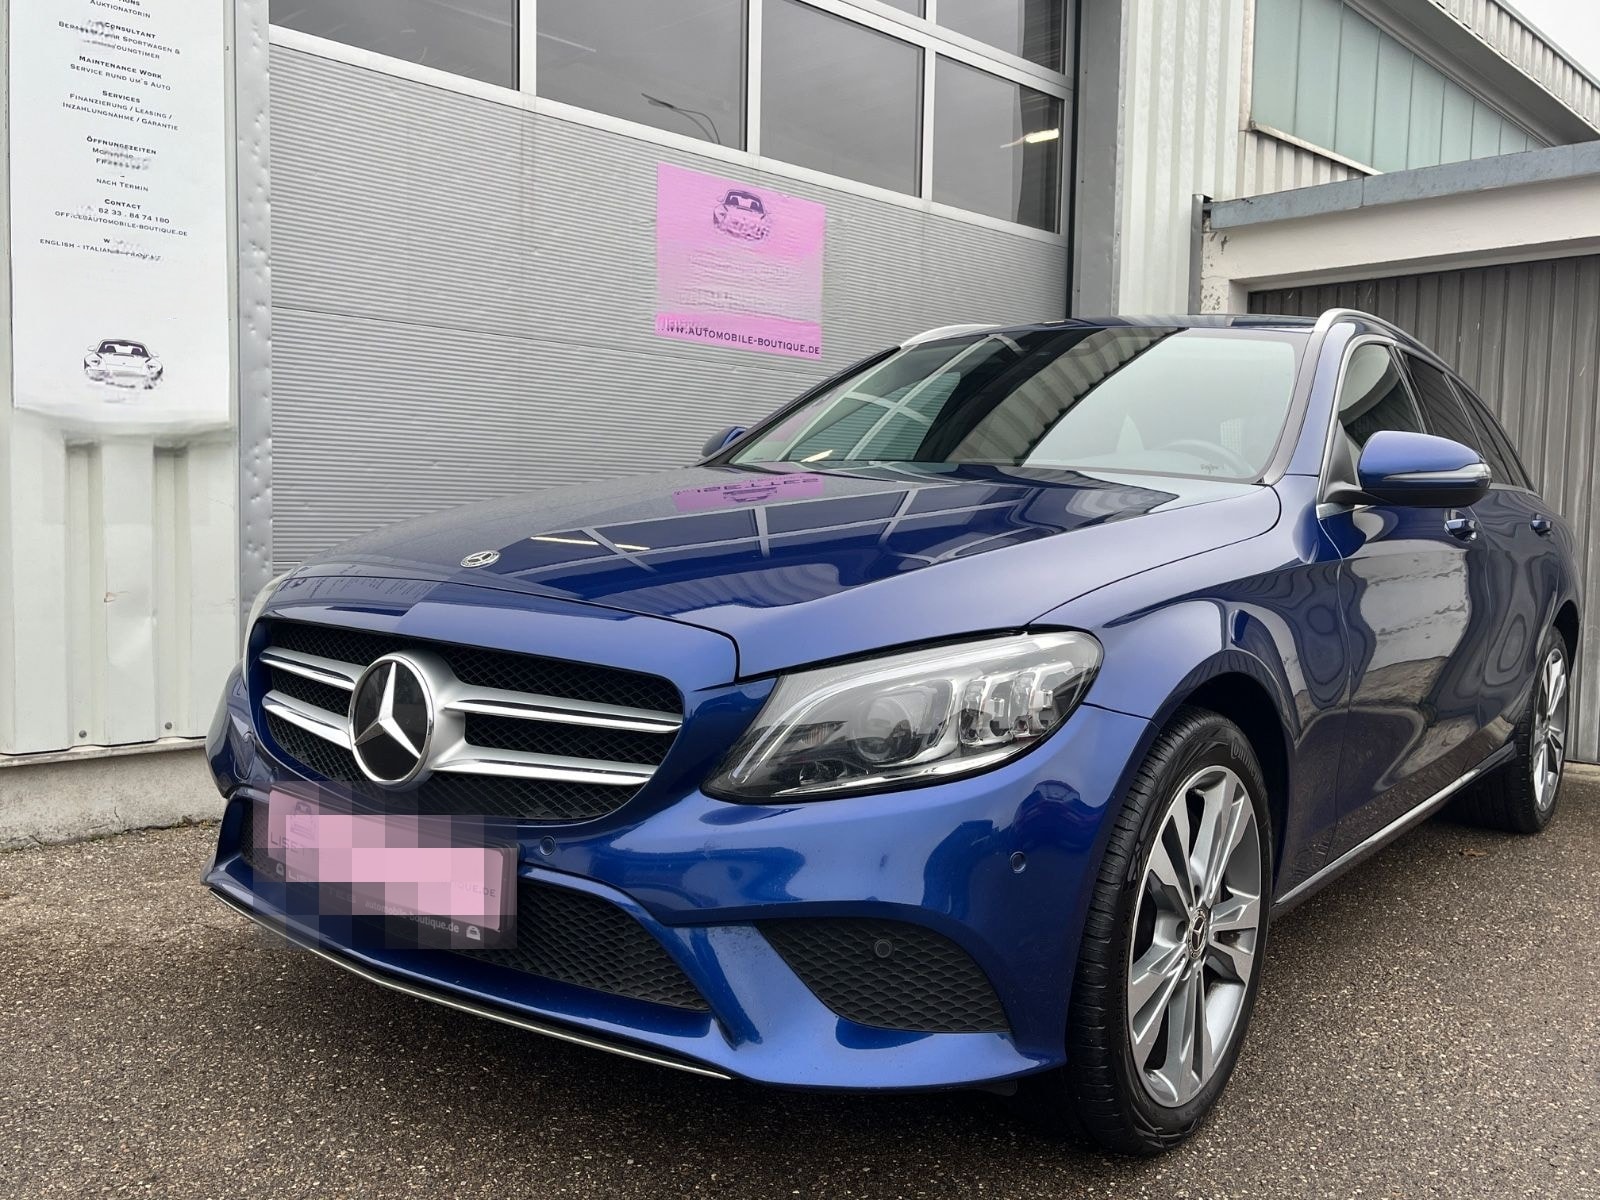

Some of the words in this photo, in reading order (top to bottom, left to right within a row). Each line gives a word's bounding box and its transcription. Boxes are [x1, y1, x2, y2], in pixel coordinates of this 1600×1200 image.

[90, 0, 151, 19] AUKTIONATORIN
[104, 22, 156, 39] CONSULTANT
[122, 36, 172, 53] SPORTWAGEN
[79, 55, 137, 74] MAINTENANCE
[139, 69, 162, 79] WORK
[70, 63, 103, 76] SERVICE
[105, 71, 127, 81] RUND
[150, 81, 171, 91] AUTO
[102, 90, 141, 103] SERVICES
[69, 93, 128, 111] FINANZIERUNG
[135, 107, 167, 119] LEASING
[62, 102, 134, 121] INZAHLUNGNAHME
[141, 118, 178, 131] GARANTIE
[96, 178, 117, 186] NACH
[119, 181, 149, 191] TERMIN
[104, 198, 141, 210] CONTACT
[40, 238, 75, 249] ENGLISH
[657, 326, 820, 355] WW.AUTOMOBILE-BOUTIQUE.DE
